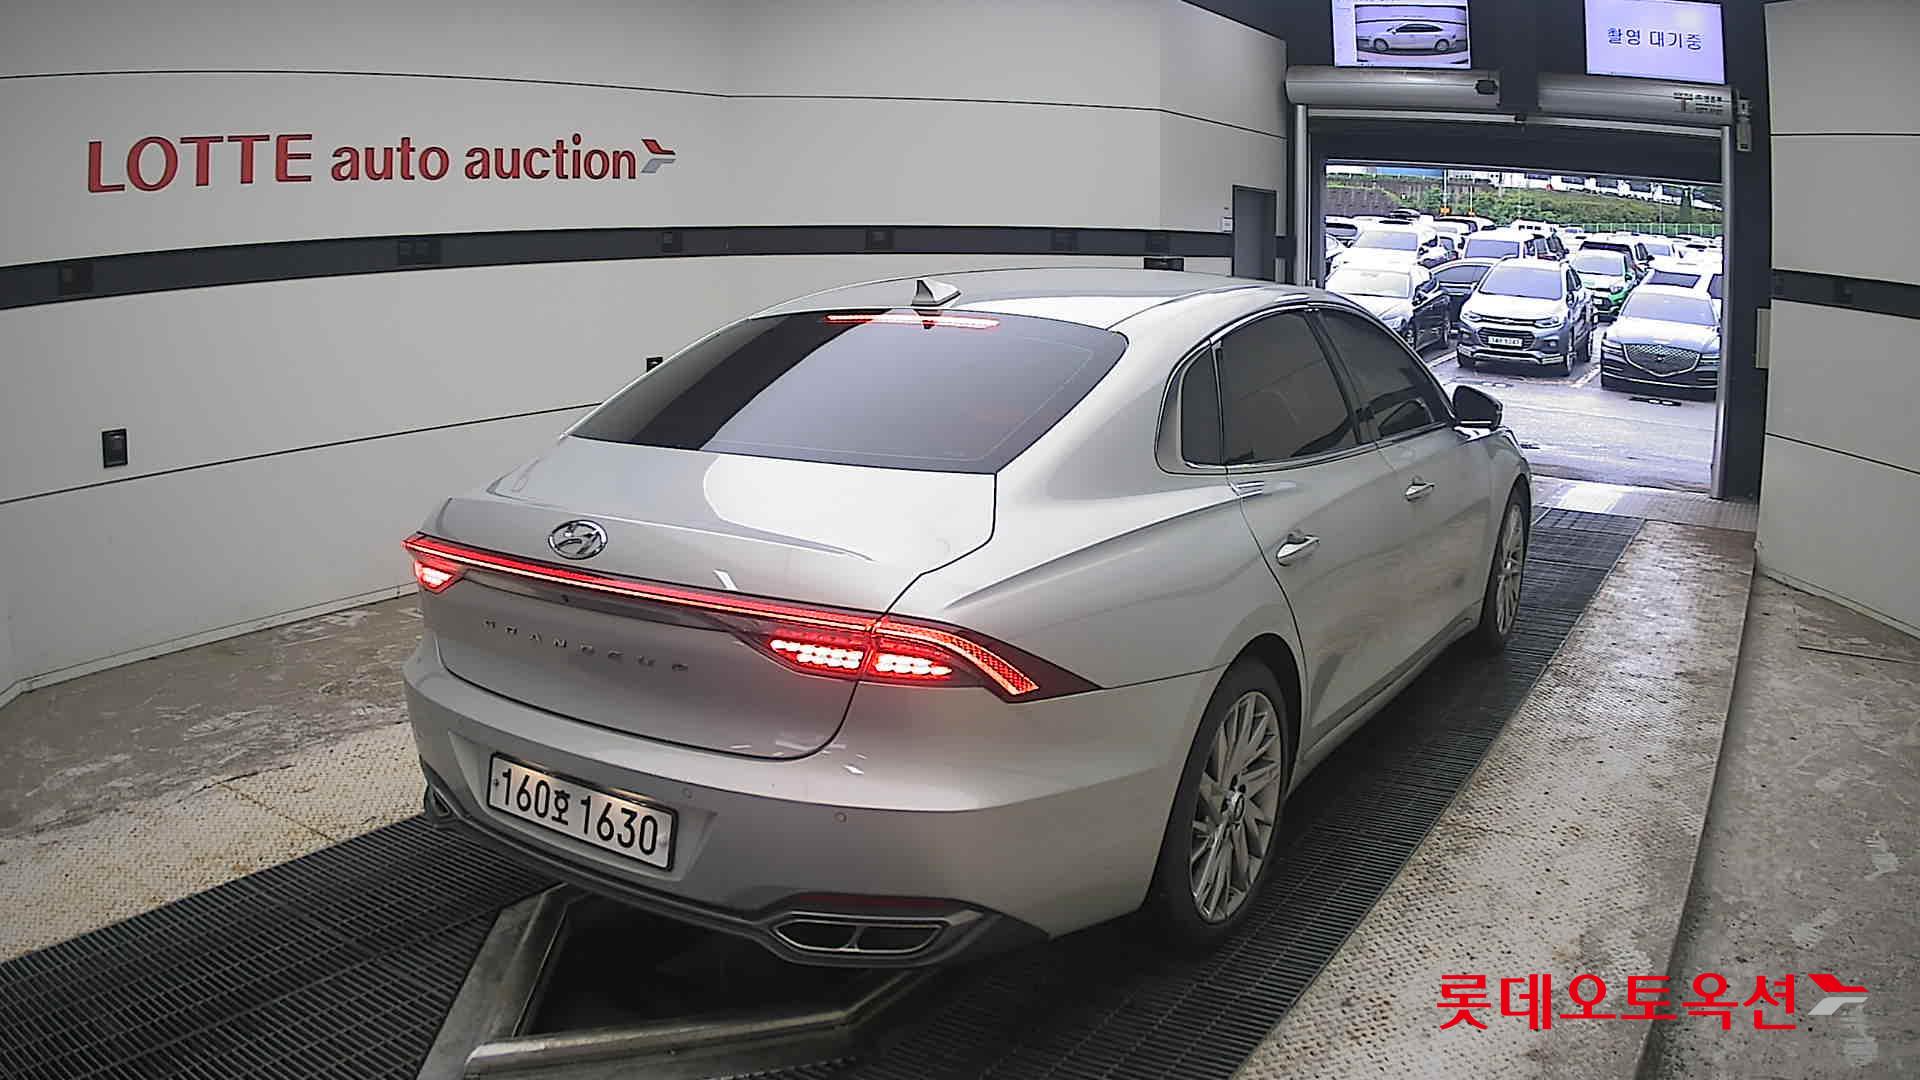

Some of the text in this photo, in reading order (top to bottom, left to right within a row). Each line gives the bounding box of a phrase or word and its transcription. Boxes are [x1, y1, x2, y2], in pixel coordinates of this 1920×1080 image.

[1649, 31, 1702, 50] 대기중
[88, 133, 637, 193] LOTTE auto auction
[502, 767, 659, 856] 160호 1630
